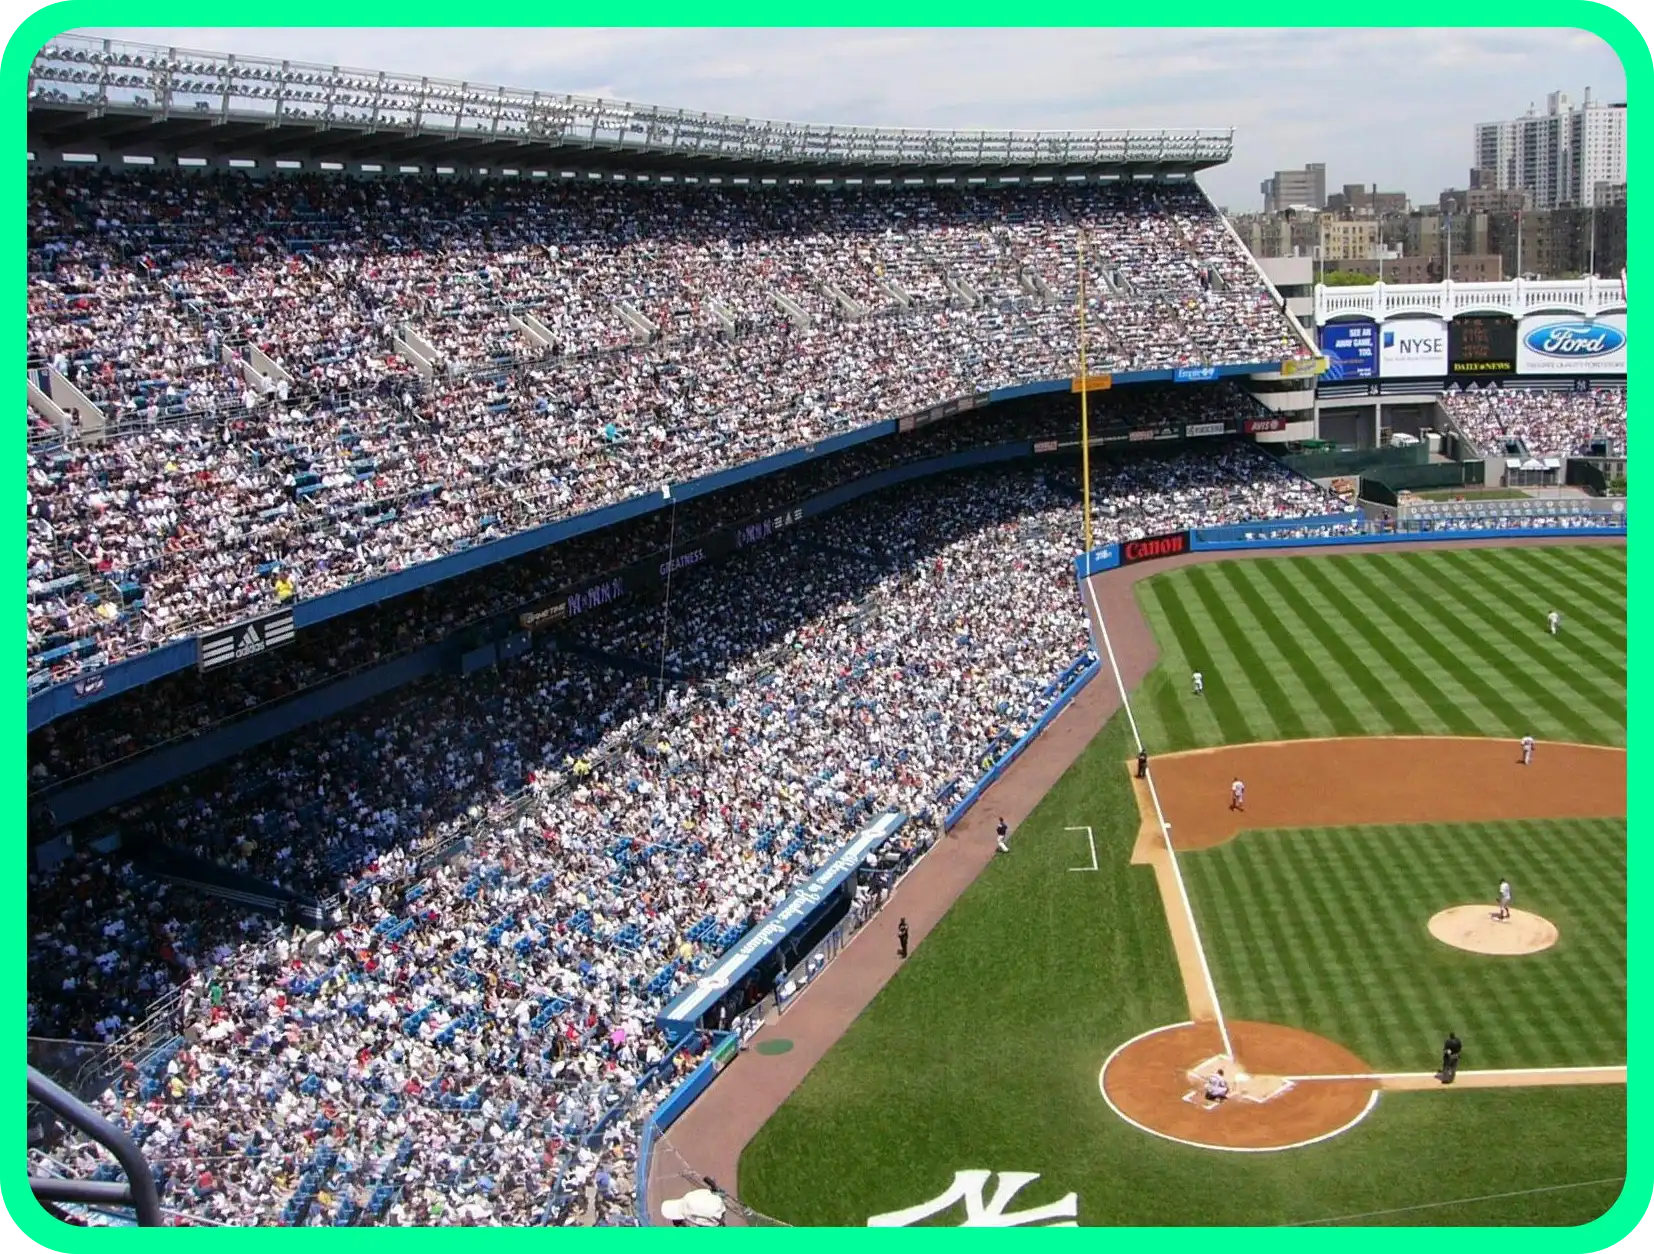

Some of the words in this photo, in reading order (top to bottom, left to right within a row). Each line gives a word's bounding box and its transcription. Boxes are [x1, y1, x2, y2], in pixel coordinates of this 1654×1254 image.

[1399, 338, 1443, 354] NYSE
[1544, 327, 1605, 352] Ford
[1454, 362, 1478, 371] DAILY
[1485, 361, 1511, 370] NEWS
[1251, 421, 1270, 431] AVIS
[1126, 536, 1183, 560] Canon
[235, 641, 265, 658] adidas
